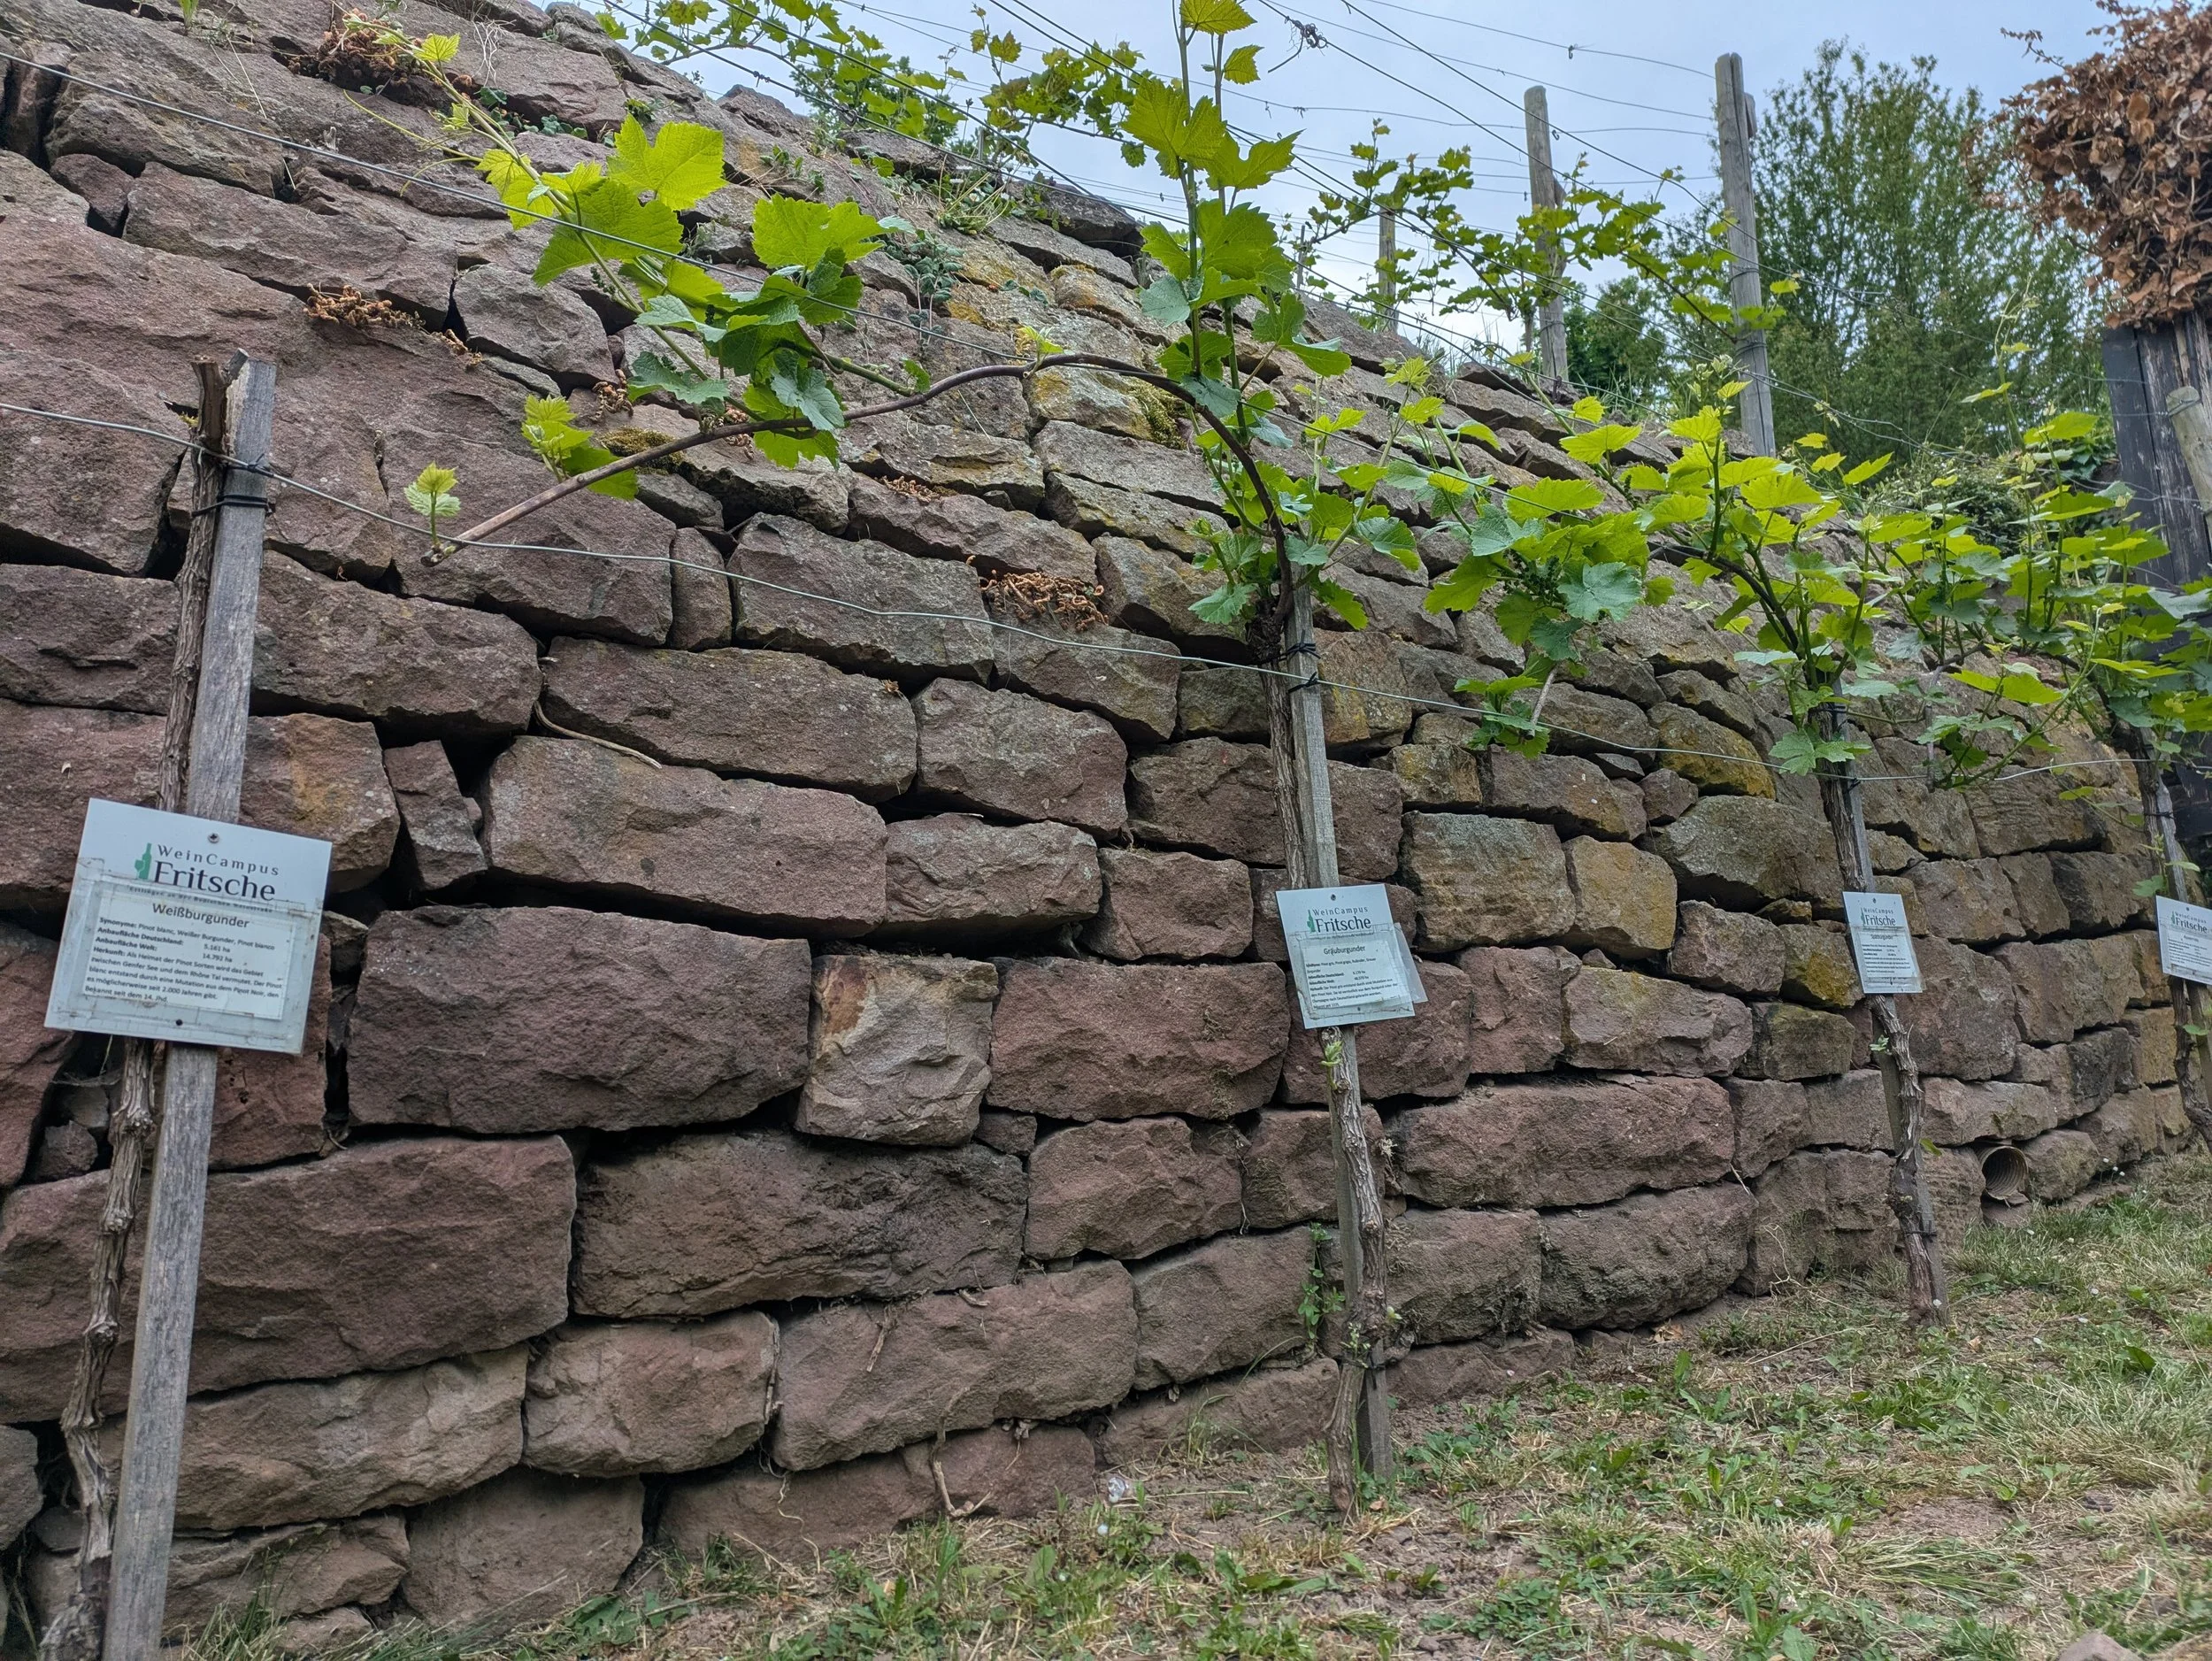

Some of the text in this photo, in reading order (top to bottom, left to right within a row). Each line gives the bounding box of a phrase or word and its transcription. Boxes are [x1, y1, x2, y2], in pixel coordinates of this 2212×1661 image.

[157, 843, 279, 876] WeinCampus
[154, 859, 276, 902] Fritsche
[152, 903, 250, 928] Weißburgunder
[1312, 906, 1369, 917] WeinCampus
[1315, 916, 1371, 933] Fritsche
[1865, 914, 1896, 927] Fritsche
[2176, 917, 2208, 933] Fritsche
[97, 927, 139, 938] Anbaufläche
[141, 934, 184, 945] Deutschland:
[100, 917, 137, 928] Synonyme:
[255, 942, 275, 950] bianco
[96, 936, 137, 949] Anbaufläche
[139, 942, 157, 951] Welt:
[91, 957, 121, 965] zwischen
[122, 961, 145, 970] Genfer
[93, 946, 125, 957] Herkunft:
[138, 953, 162, 962] Heimat
[194, 961, 214, 970] Sorten
[243, 968, 264, 977] Gebiet
[88, 965, 107, 974] blanc
[108, 969, 138, 979] entstand
[175, 979, 204, 988] Mutation
[233, 987, 250, 996] Pinot
[96, 977, 148, 990] möglicherweise
[85, 985, 112, 995] Bekannt
